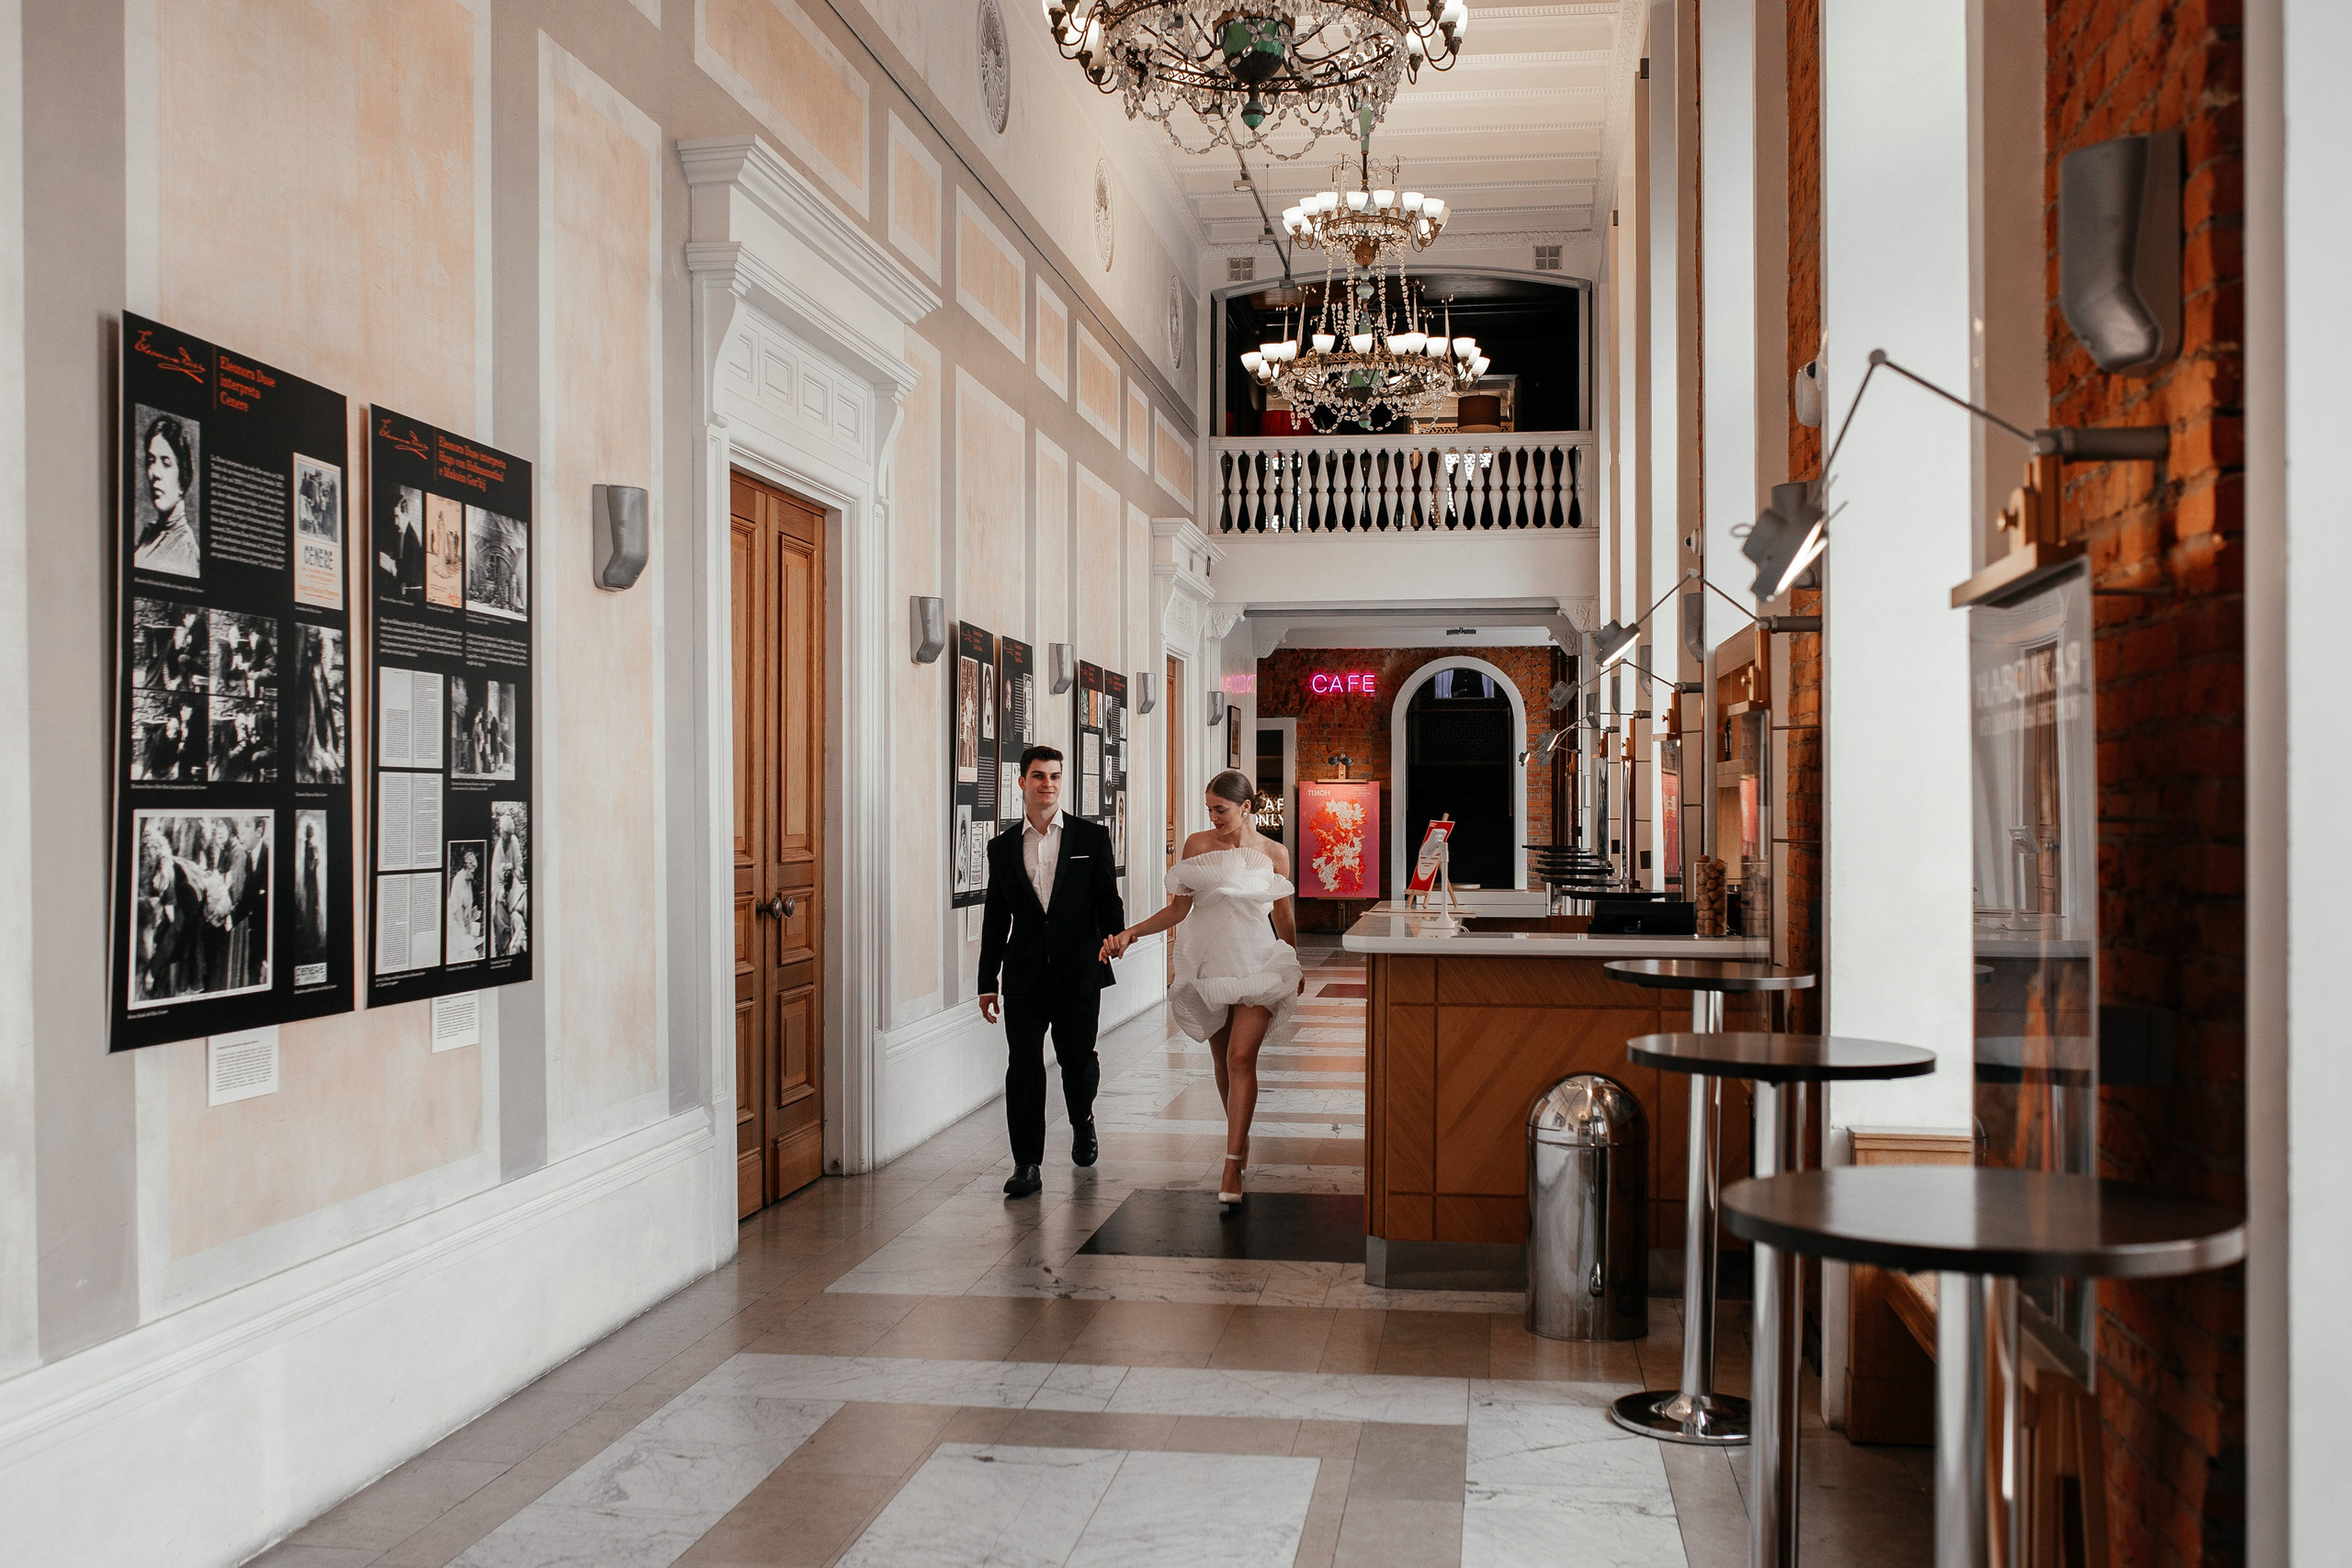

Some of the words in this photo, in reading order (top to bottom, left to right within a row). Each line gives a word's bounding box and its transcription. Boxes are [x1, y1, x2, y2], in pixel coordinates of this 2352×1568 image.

[220, 355, 255, 380] Eleonora
[256, 369, 276, 388] Duse
[220, 373, 261, 399] interpreta
[220, 390, 249, 412] Cenere
[438, 435, 464, 455] Eleonora
[1312, 674, 1375, 694] CAFE
